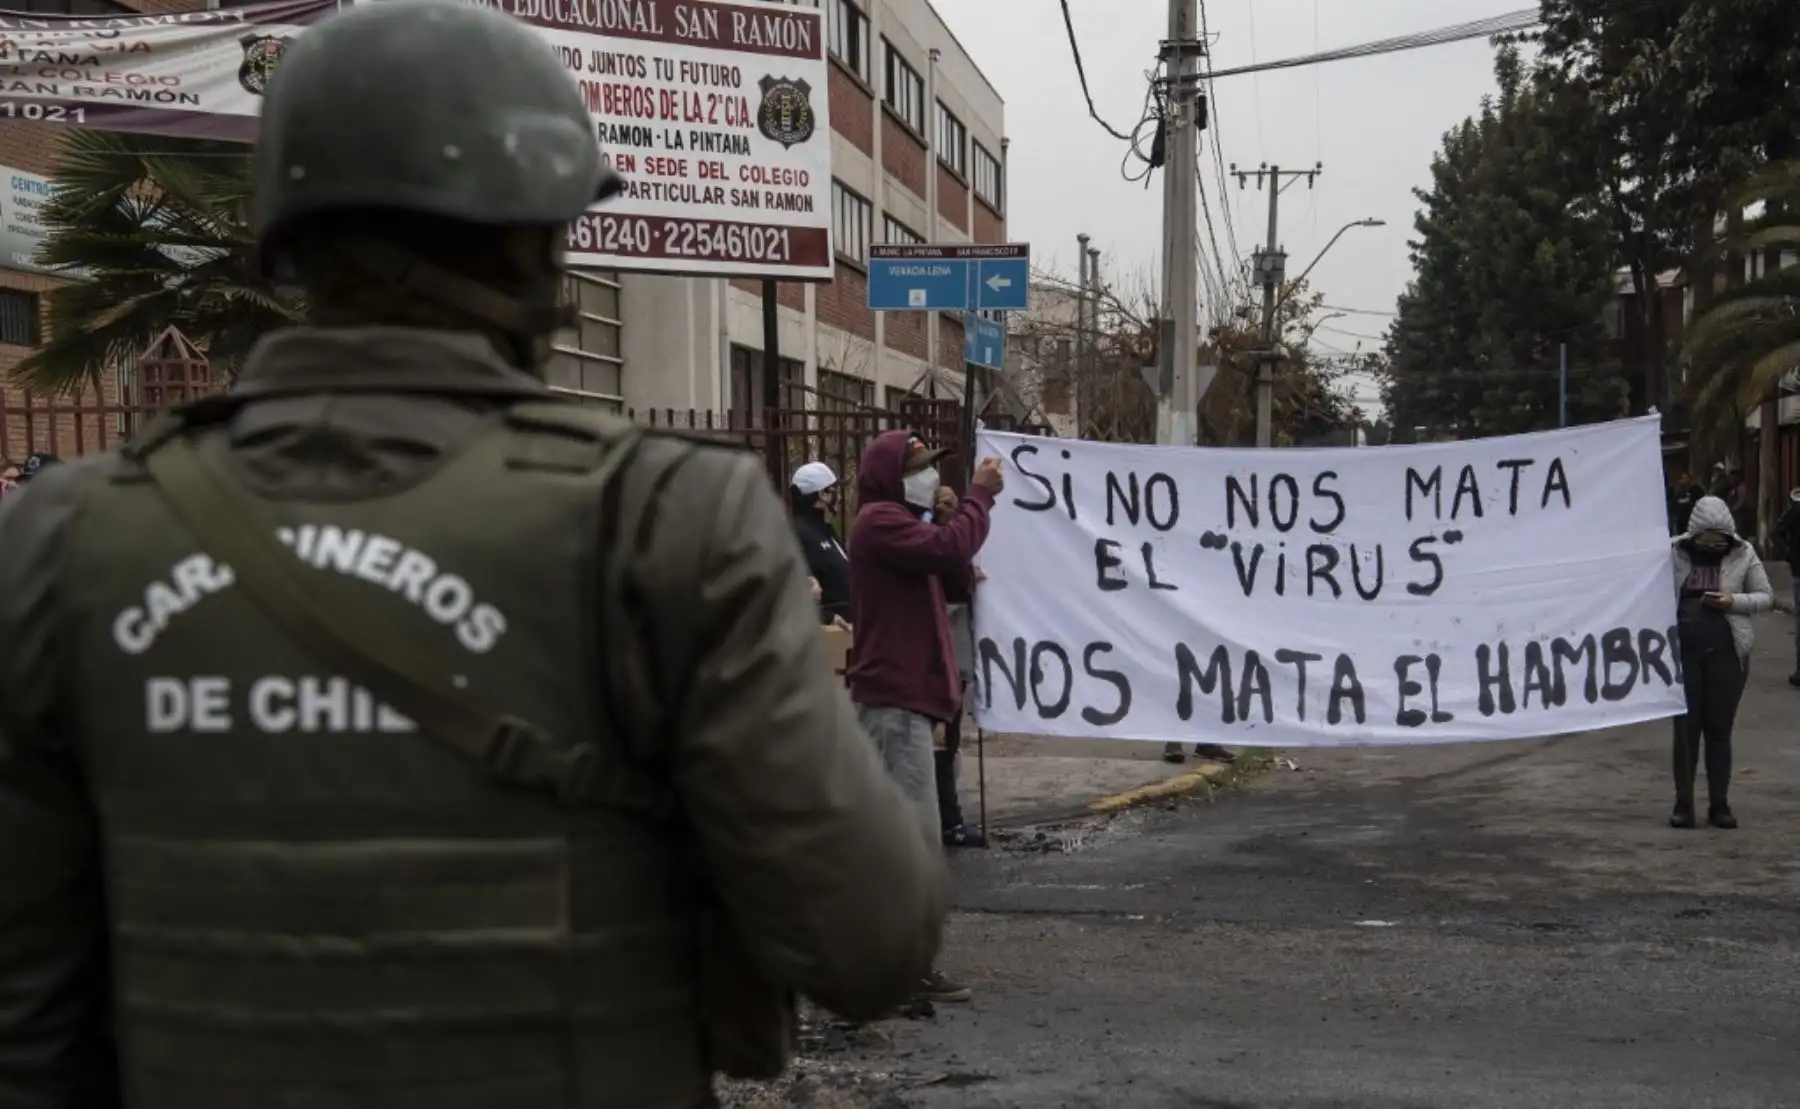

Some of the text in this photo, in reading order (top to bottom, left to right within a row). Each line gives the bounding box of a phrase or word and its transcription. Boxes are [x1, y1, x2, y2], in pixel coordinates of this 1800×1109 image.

[675, 5, 720, 41] SAN
[732, 11, 812, 51] RAMÓN
[0, 80, 59, 95] AN
[38, 67, 181, 85] COLEGIO
[588, 49, 647, 79] JUNTOS
[653, 57, 674, 82] TU
[680, 60, 742, 88] FUTURO
[659, 88, 679, 121] DE
[683, 91, 703, 124] LA
[598, 122, 751, 156] RAMON LA PINTANA
[616, 153, 636, 173] EN
[645, 155, 688, 179] SEDE
[698, 160, 730, 181] DEL
[739, 164, 810, 187] COLEGIO
[619, 180, 814, 213] PARTICULAR SAN RAMON
[664, 221, 791, 261] 225461021
[1105, 471, 1180, 531] NO
[1225, 470, 1346, 534] NOS
[1405, 456, 1572, 521] MATA
[1095, 538, 1179, 591] EL
[113, 524, 508, 655] CARINEROS
[979, 636, 1133, 727] NOS
[1175, 642, 1366, 725] MATA
[1393, 653, 1454, 728] EL
[146, 676, 419, 733] DE CHIL
